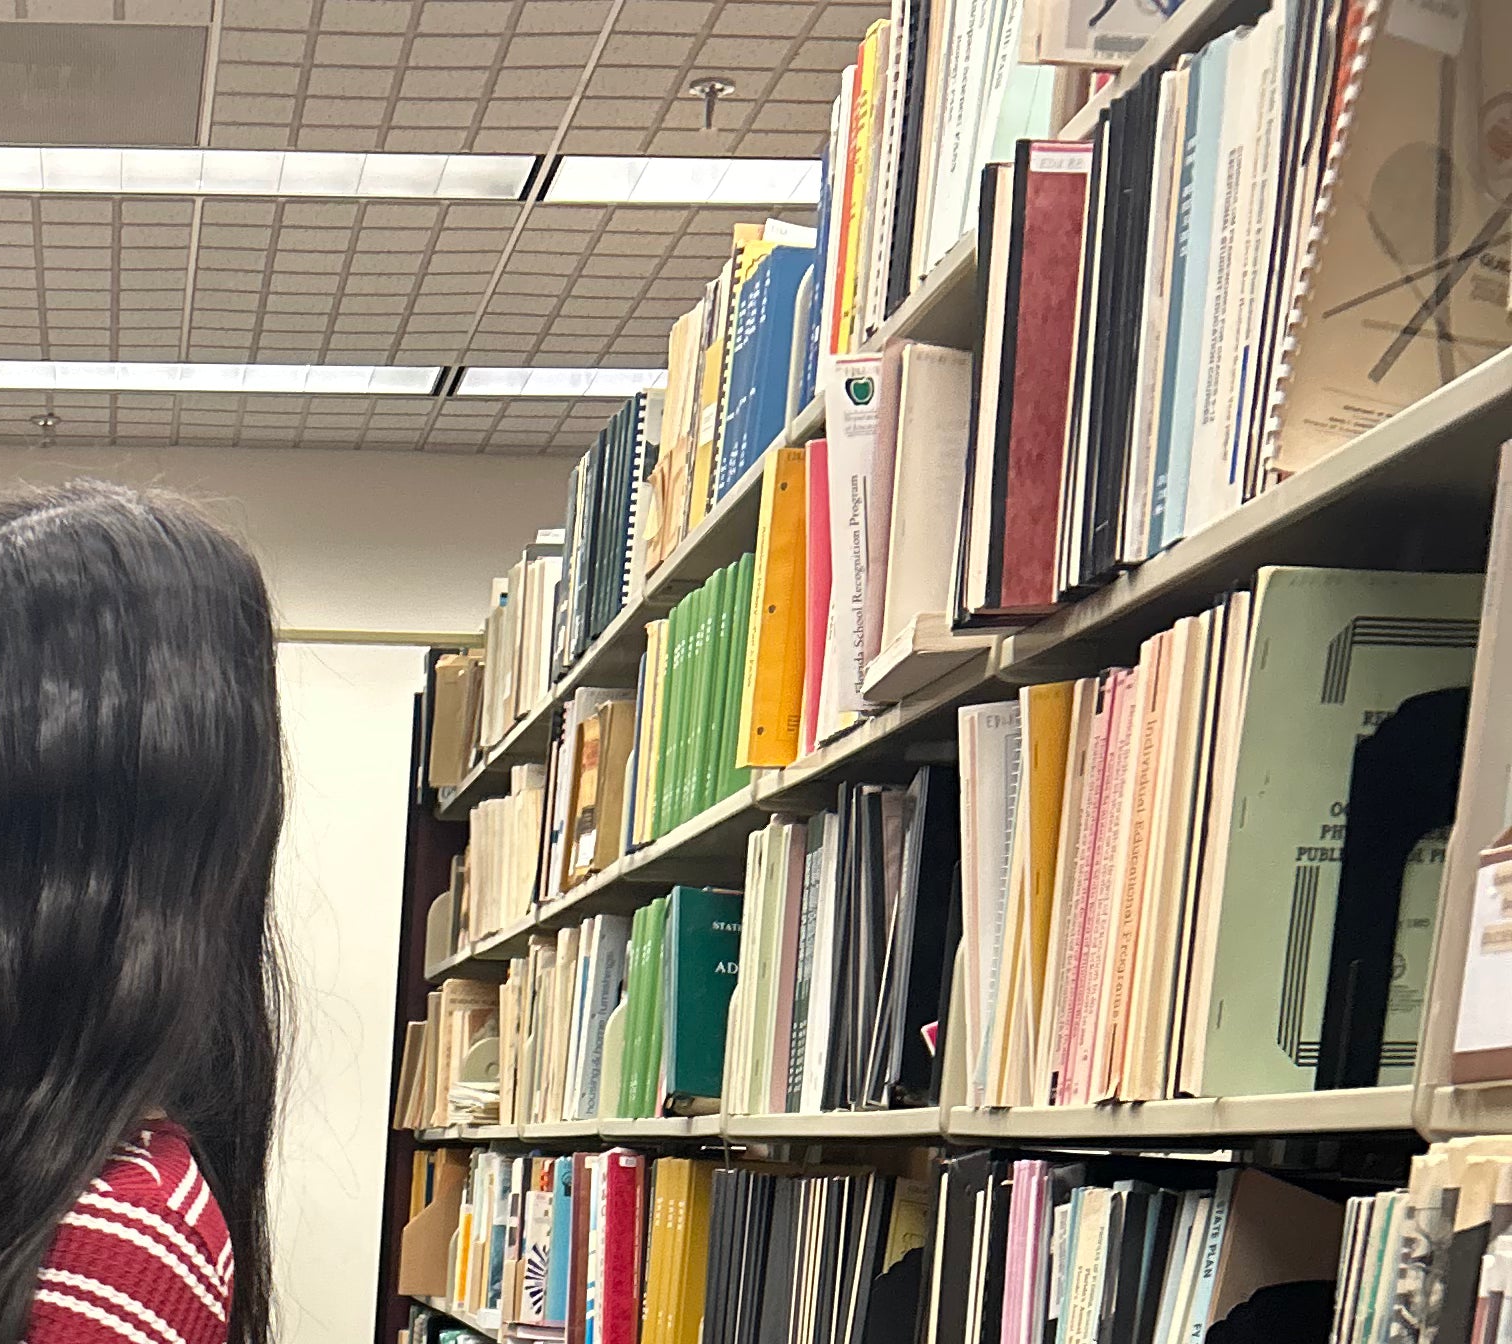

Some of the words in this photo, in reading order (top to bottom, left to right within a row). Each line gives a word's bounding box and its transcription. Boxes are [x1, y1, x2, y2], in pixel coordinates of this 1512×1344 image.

[849, 474, 863, 527] Program
[851, 530, 865, 606] Recognition
[853, 607, 864, 652] School
[1134, 718, 1158, 813] Individual
[1121, 820, 1146, 925] Educational
[597, 950, 617, 1015] furnishings
[592, 1018, 605, 1055] home
[584, 1067, 601, 1115] housing
[1209, 1198, 1227, 1240] STATE
[1201, 1242, 1218, 1280] PLAN
[1190, 1322, 1202, 1340] FY
